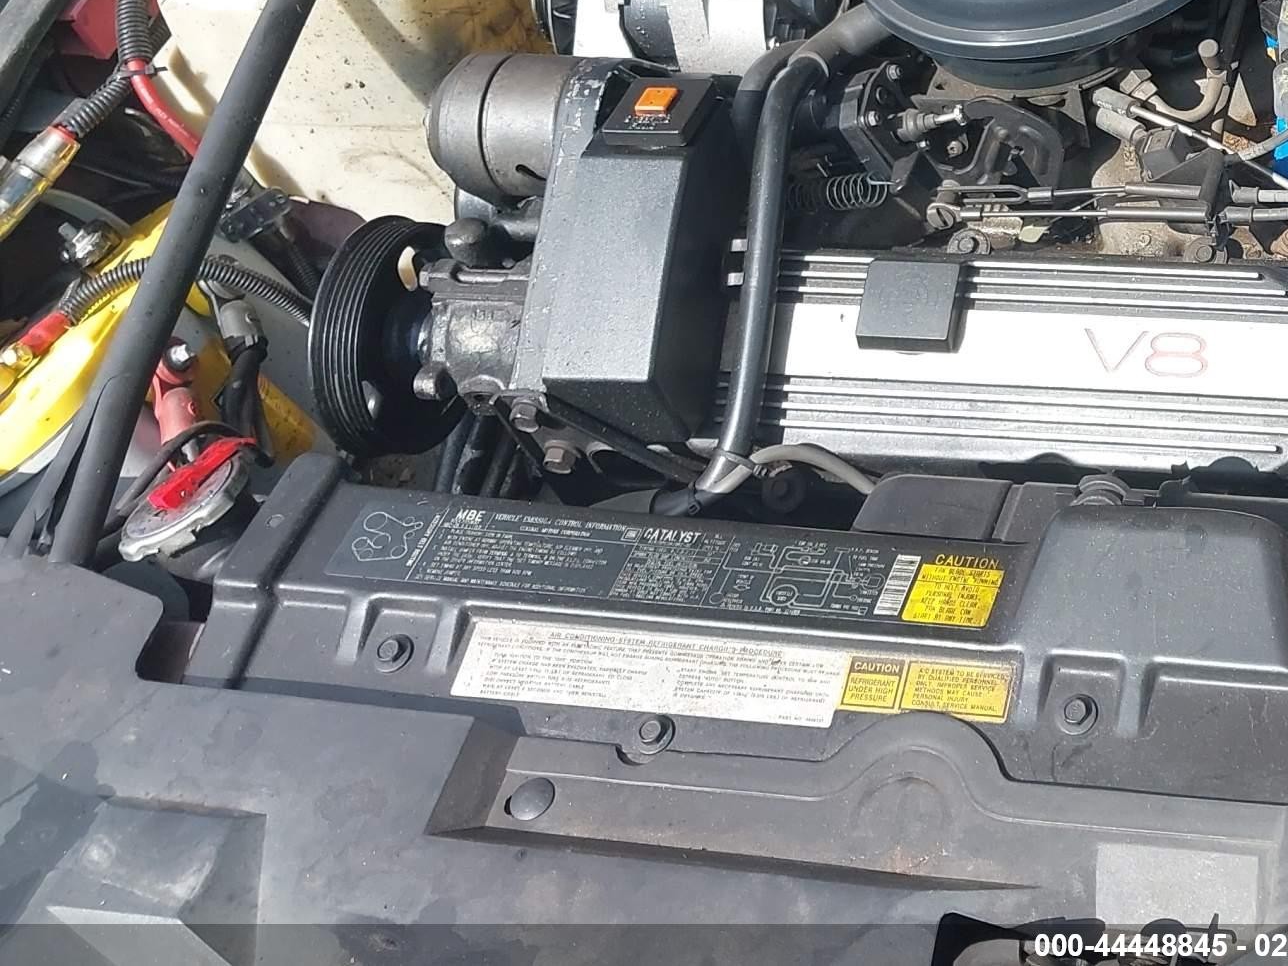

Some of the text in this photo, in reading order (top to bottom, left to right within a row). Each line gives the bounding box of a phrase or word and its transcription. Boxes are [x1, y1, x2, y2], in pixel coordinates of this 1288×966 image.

[1084, 328, 1208, 378] V8
[456, 509, 486, 522] MBE
[554, 519, 582, 528] CONTROL
[585, 522, 626, 532] INFORMATION
[644, 528, 701, 543] CATALYST
[935, 554, 999, 569] CAUTION
[854, 662, 900, 673] CAUTION
[930, 668, 955, 676] SYSTEM
[850, 677, 895, 687] REFRIGERANT
[927, 675, 960, 683] QUALIFIED
[962, 677, 999, 686] PERSONNEL
[848, 685, 873, 694] UNDER
[914, 687, 944, 695] METHODS
[937, 682, 968, 690] IMPROPER
[970, 684, 995, 692] SERVICE
[850, 693, 888, 702] PRESSURE
[942, 702, 968, 710] SERVICE
